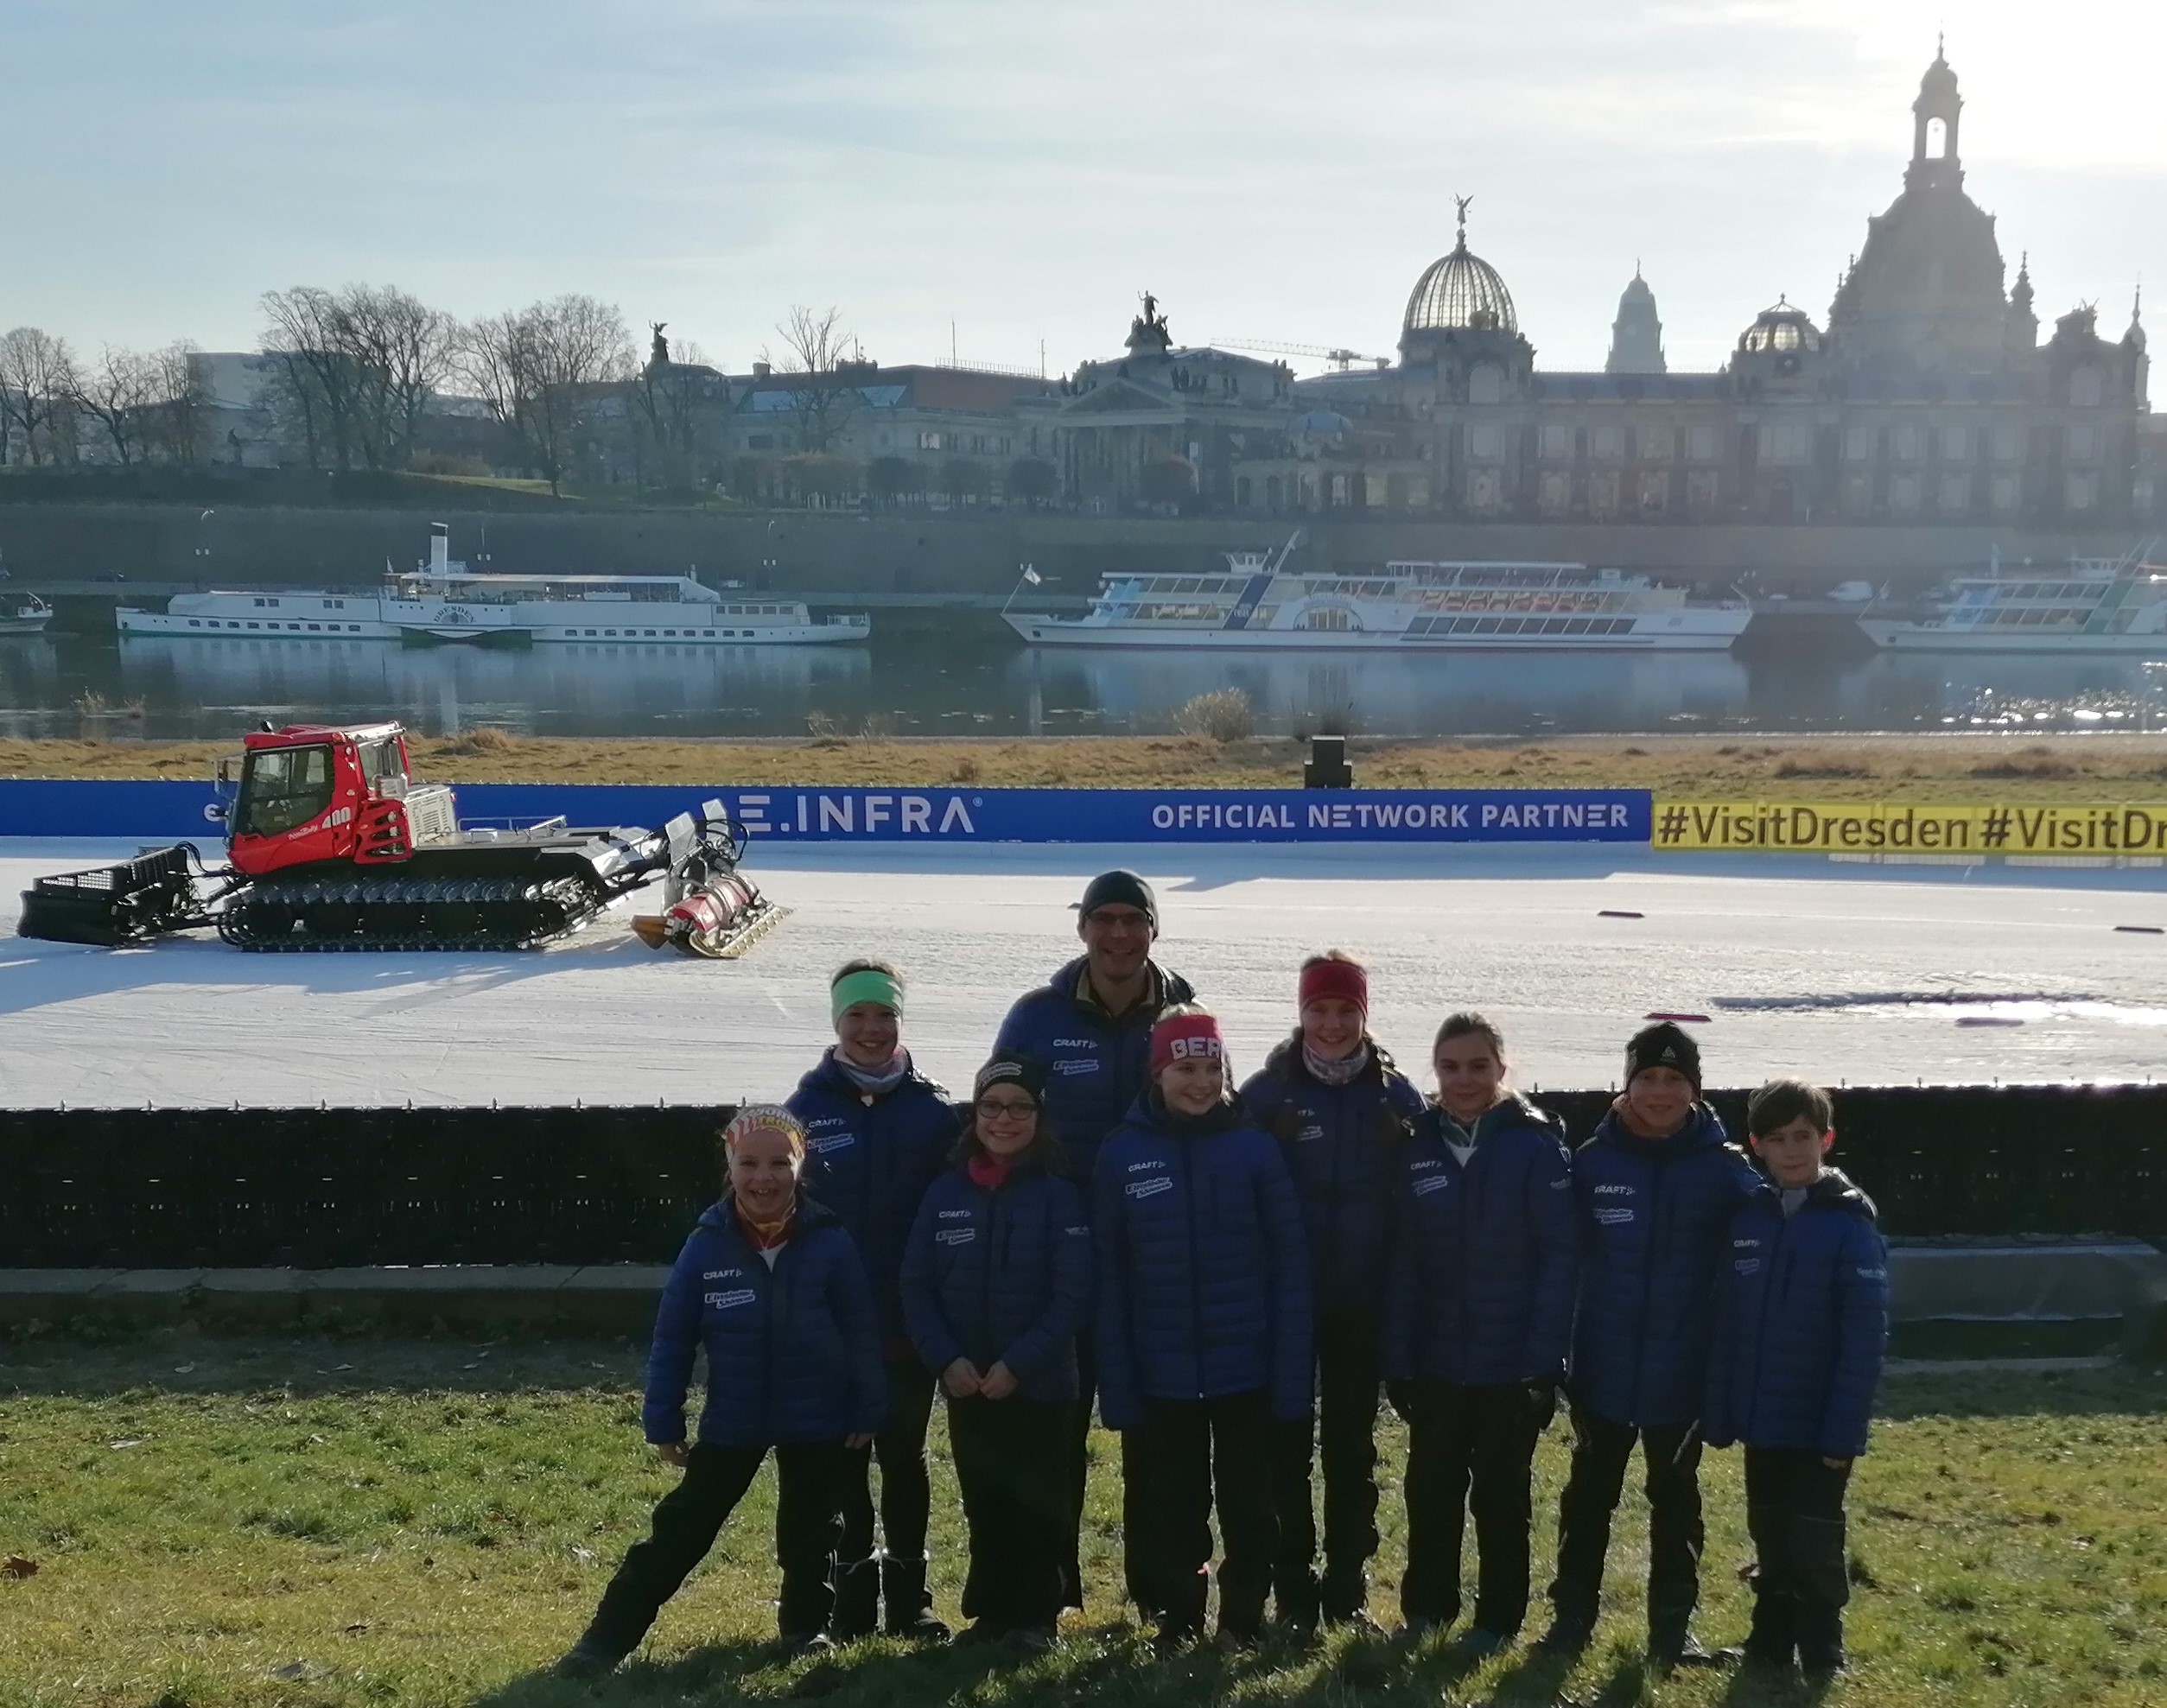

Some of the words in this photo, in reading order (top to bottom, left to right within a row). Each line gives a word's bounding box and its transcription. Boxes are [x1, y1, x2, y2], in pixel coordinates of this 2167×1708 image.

[321, 806, 351, 829] 400
[739, 795, 975, 834] E.INFRA
[1151, 804, 1295, 829] OFFICIAL
[1308, 804, 1470, 829] NETWORK
[1482, 804, 1629, 829] PARTNER
[1658, 806, 1969, 848] #VisitDresden
[1052, 1038, 1089, 1049] CRAFT
[1128, 1161, 1158, 1172] CRAFT
[1410, 1160, 1436, 1171] CRAFT
[702, 1269, 734, 1280] CRAFT
